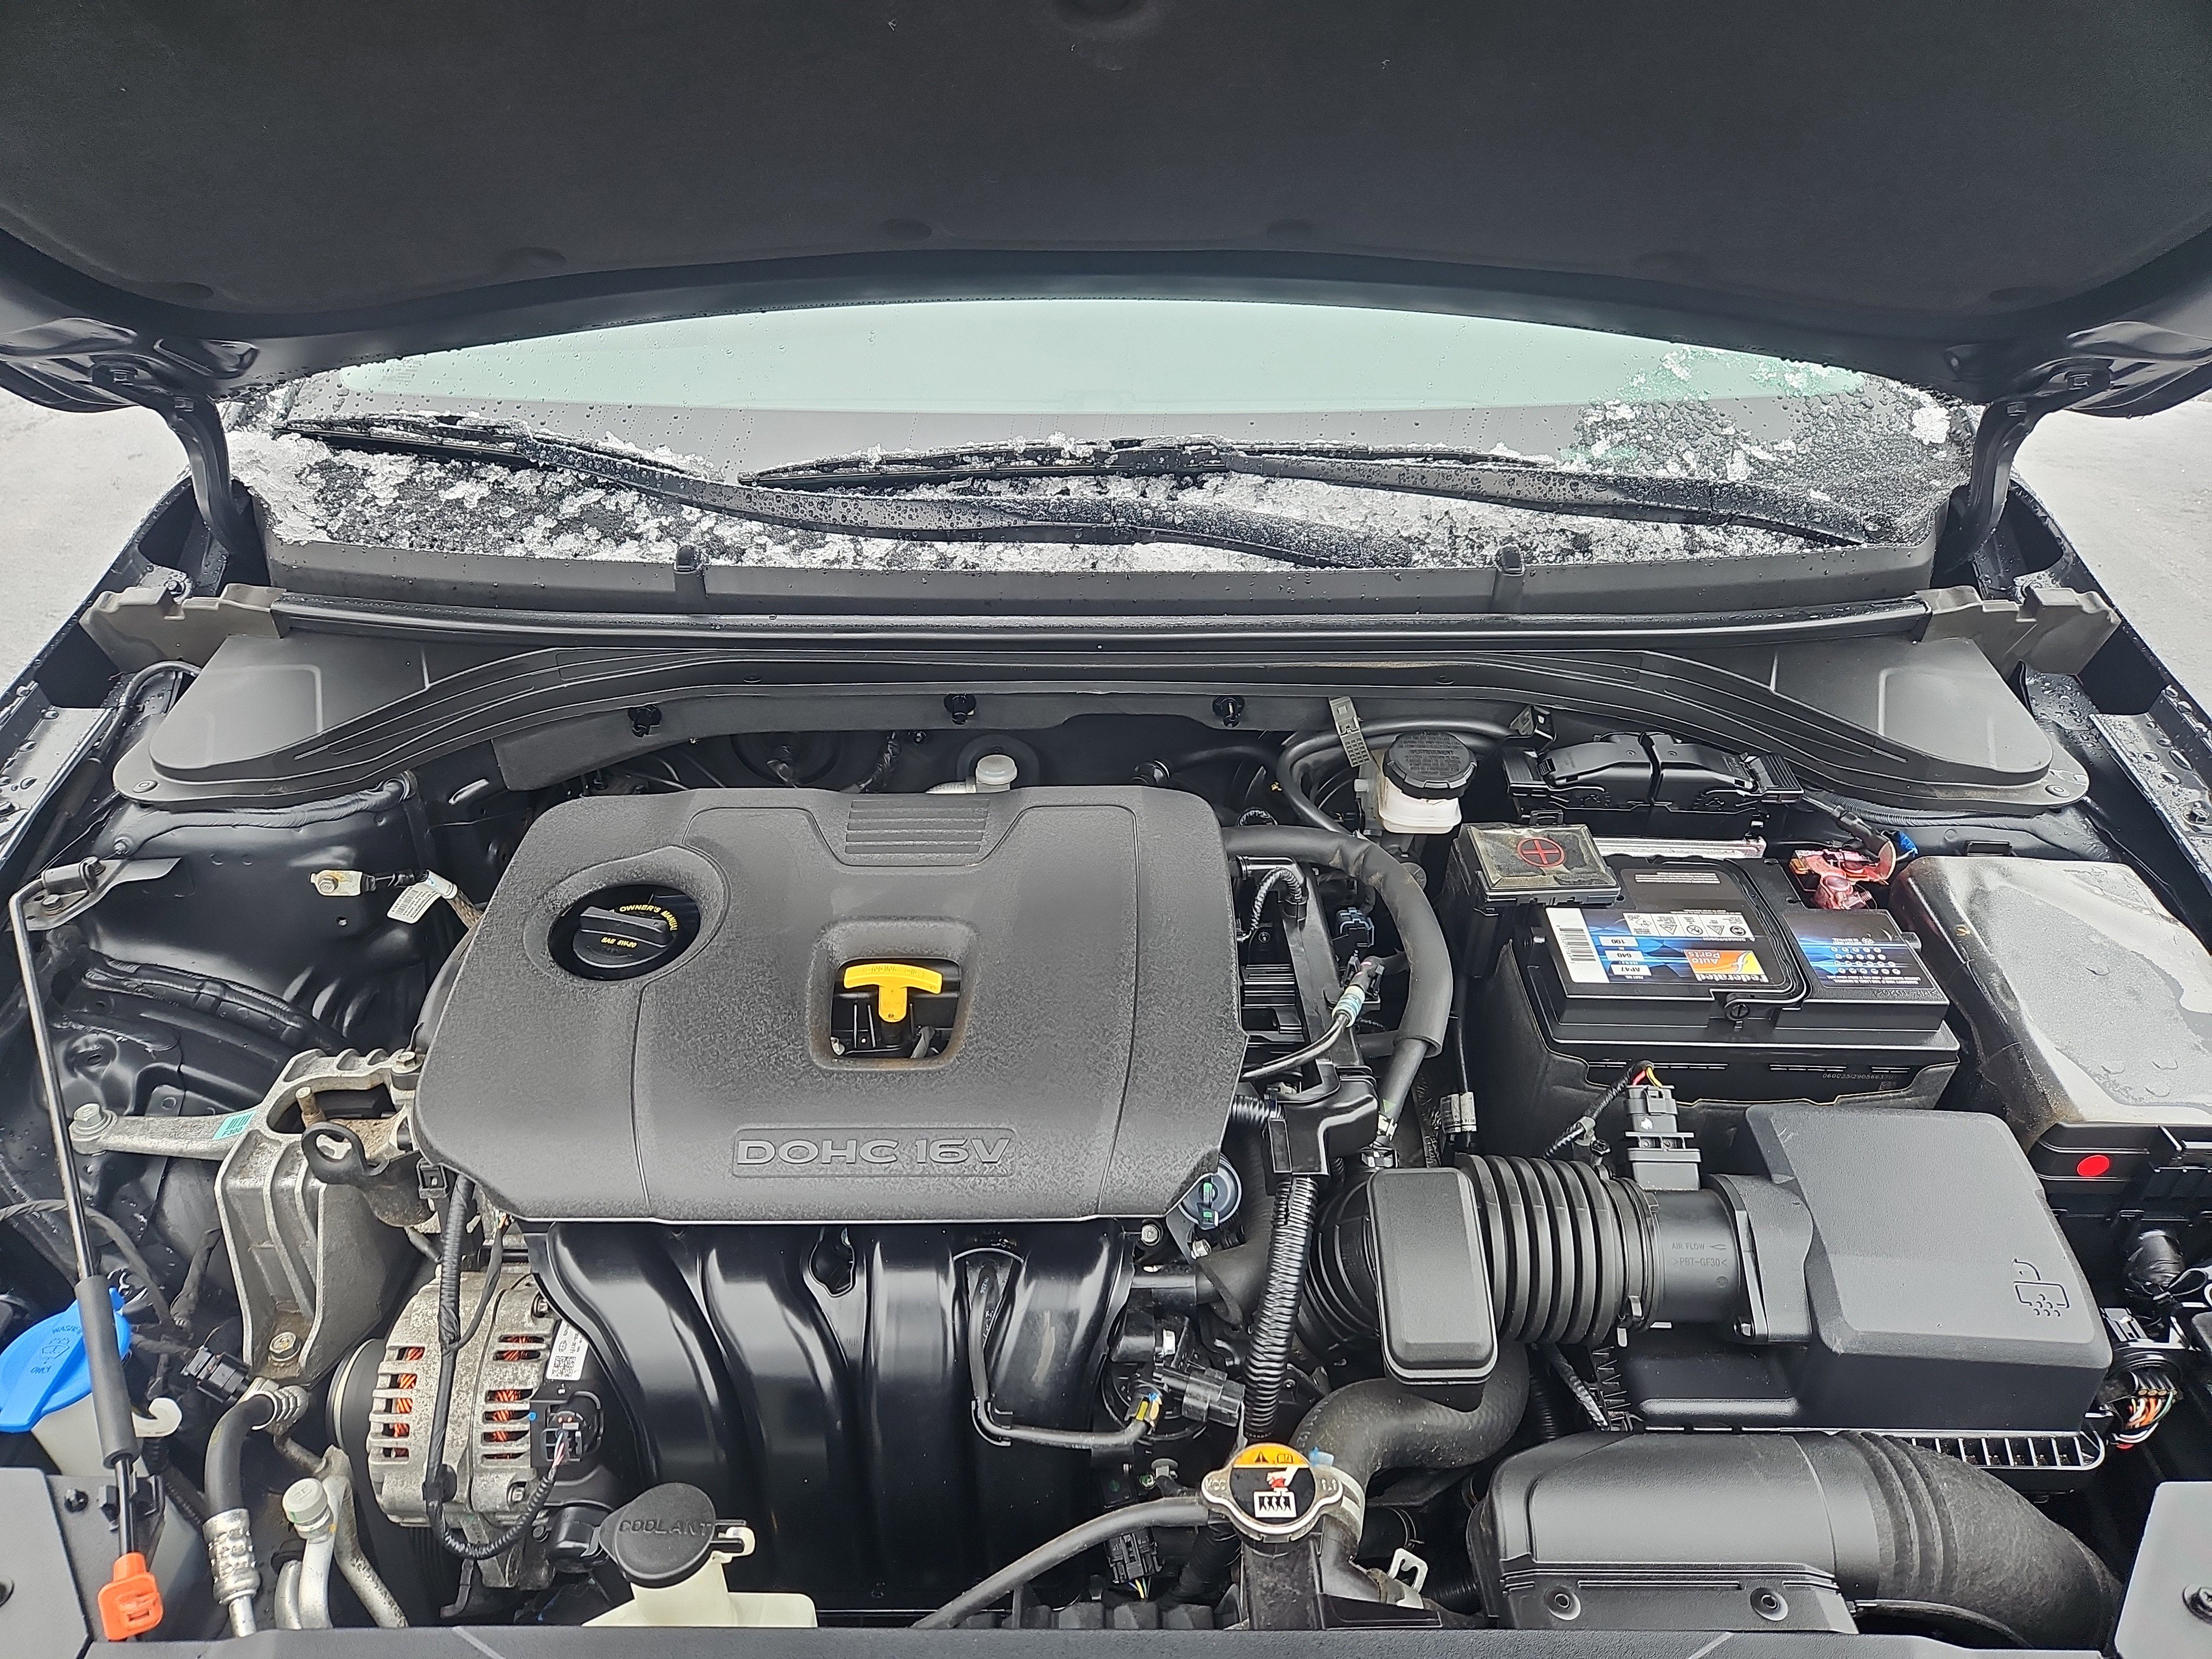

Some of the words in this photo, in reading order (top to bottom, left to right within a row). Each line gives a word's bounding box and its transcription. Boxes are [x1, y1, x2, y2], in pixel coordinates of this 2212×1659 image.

[619, 904, 661, 912] OWNER'S
[660, 910, 678, 931] MANUAL
[1688, 950, 1722, 959] Parts
[1692, 957, 1719, 965] Auto
[1696, 974, 1770, 983] Federated
[221, 1127, 243, 1137] F300
[737, 1139, 899, 1165] DOHC
[915, 1137, 1011, 1165] 16V
[30, 1366, 52, 1374] ONLY
[619, 1520, 712, 1536] COOLANT
